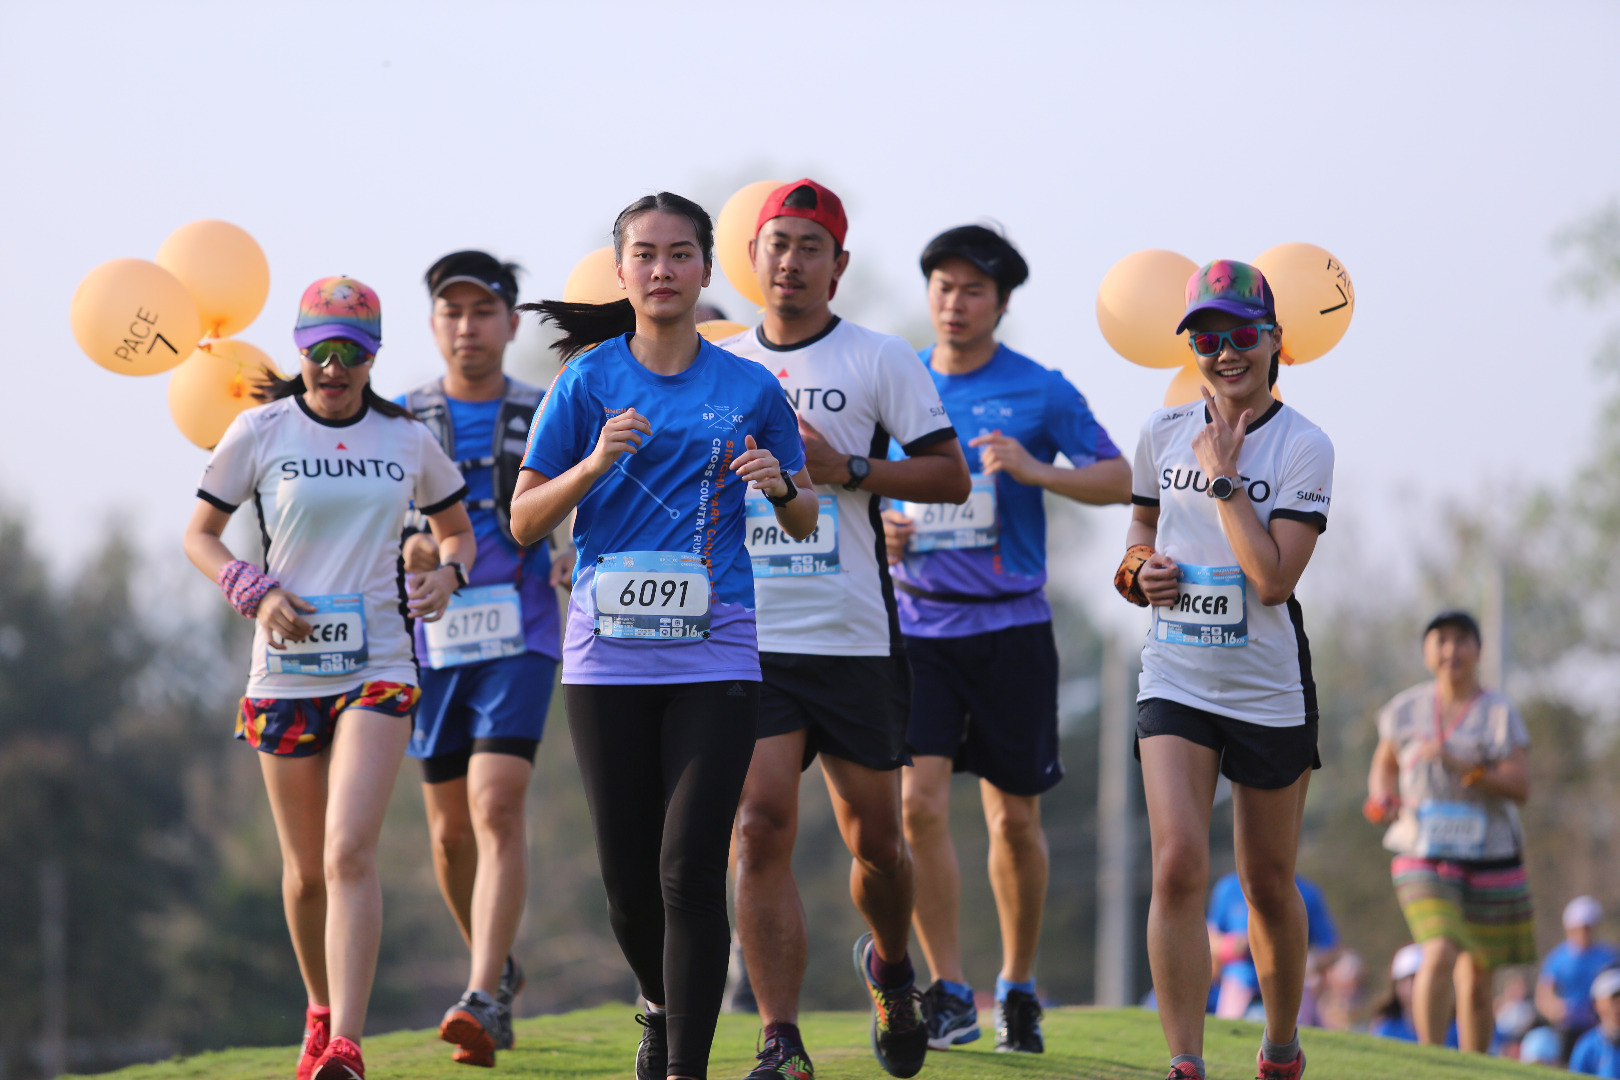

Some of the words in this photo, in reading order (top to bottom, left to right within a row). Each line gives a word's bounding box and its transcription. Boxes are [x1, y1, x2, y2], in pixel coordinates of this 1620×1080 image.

[1319, 283, 1348, 315] 7
[114, 306, 159, 363] PACE
[146, 333, 179, 354] 7
[783, 388, 846, 412] NTO
[702, 412, 715, 421] SP
[731, 414, 744, 423] XC
[281, 458, 405, 482] SUUNTO
[704, 437, 722, 477] CROSS
[715, 439, 735, 489] SINGHA
[1161, 467, 1271, 504] SUUO
[1296, 490, 1331, 507] SUUNT
[695, 479, 710, 533] COUNTRY
[692, 534, 703, 555] RUN
[751, 525, 820, 546] PACR
[619, 579, 689, 608] 6091
[447, 609, 501, 638] 6170
